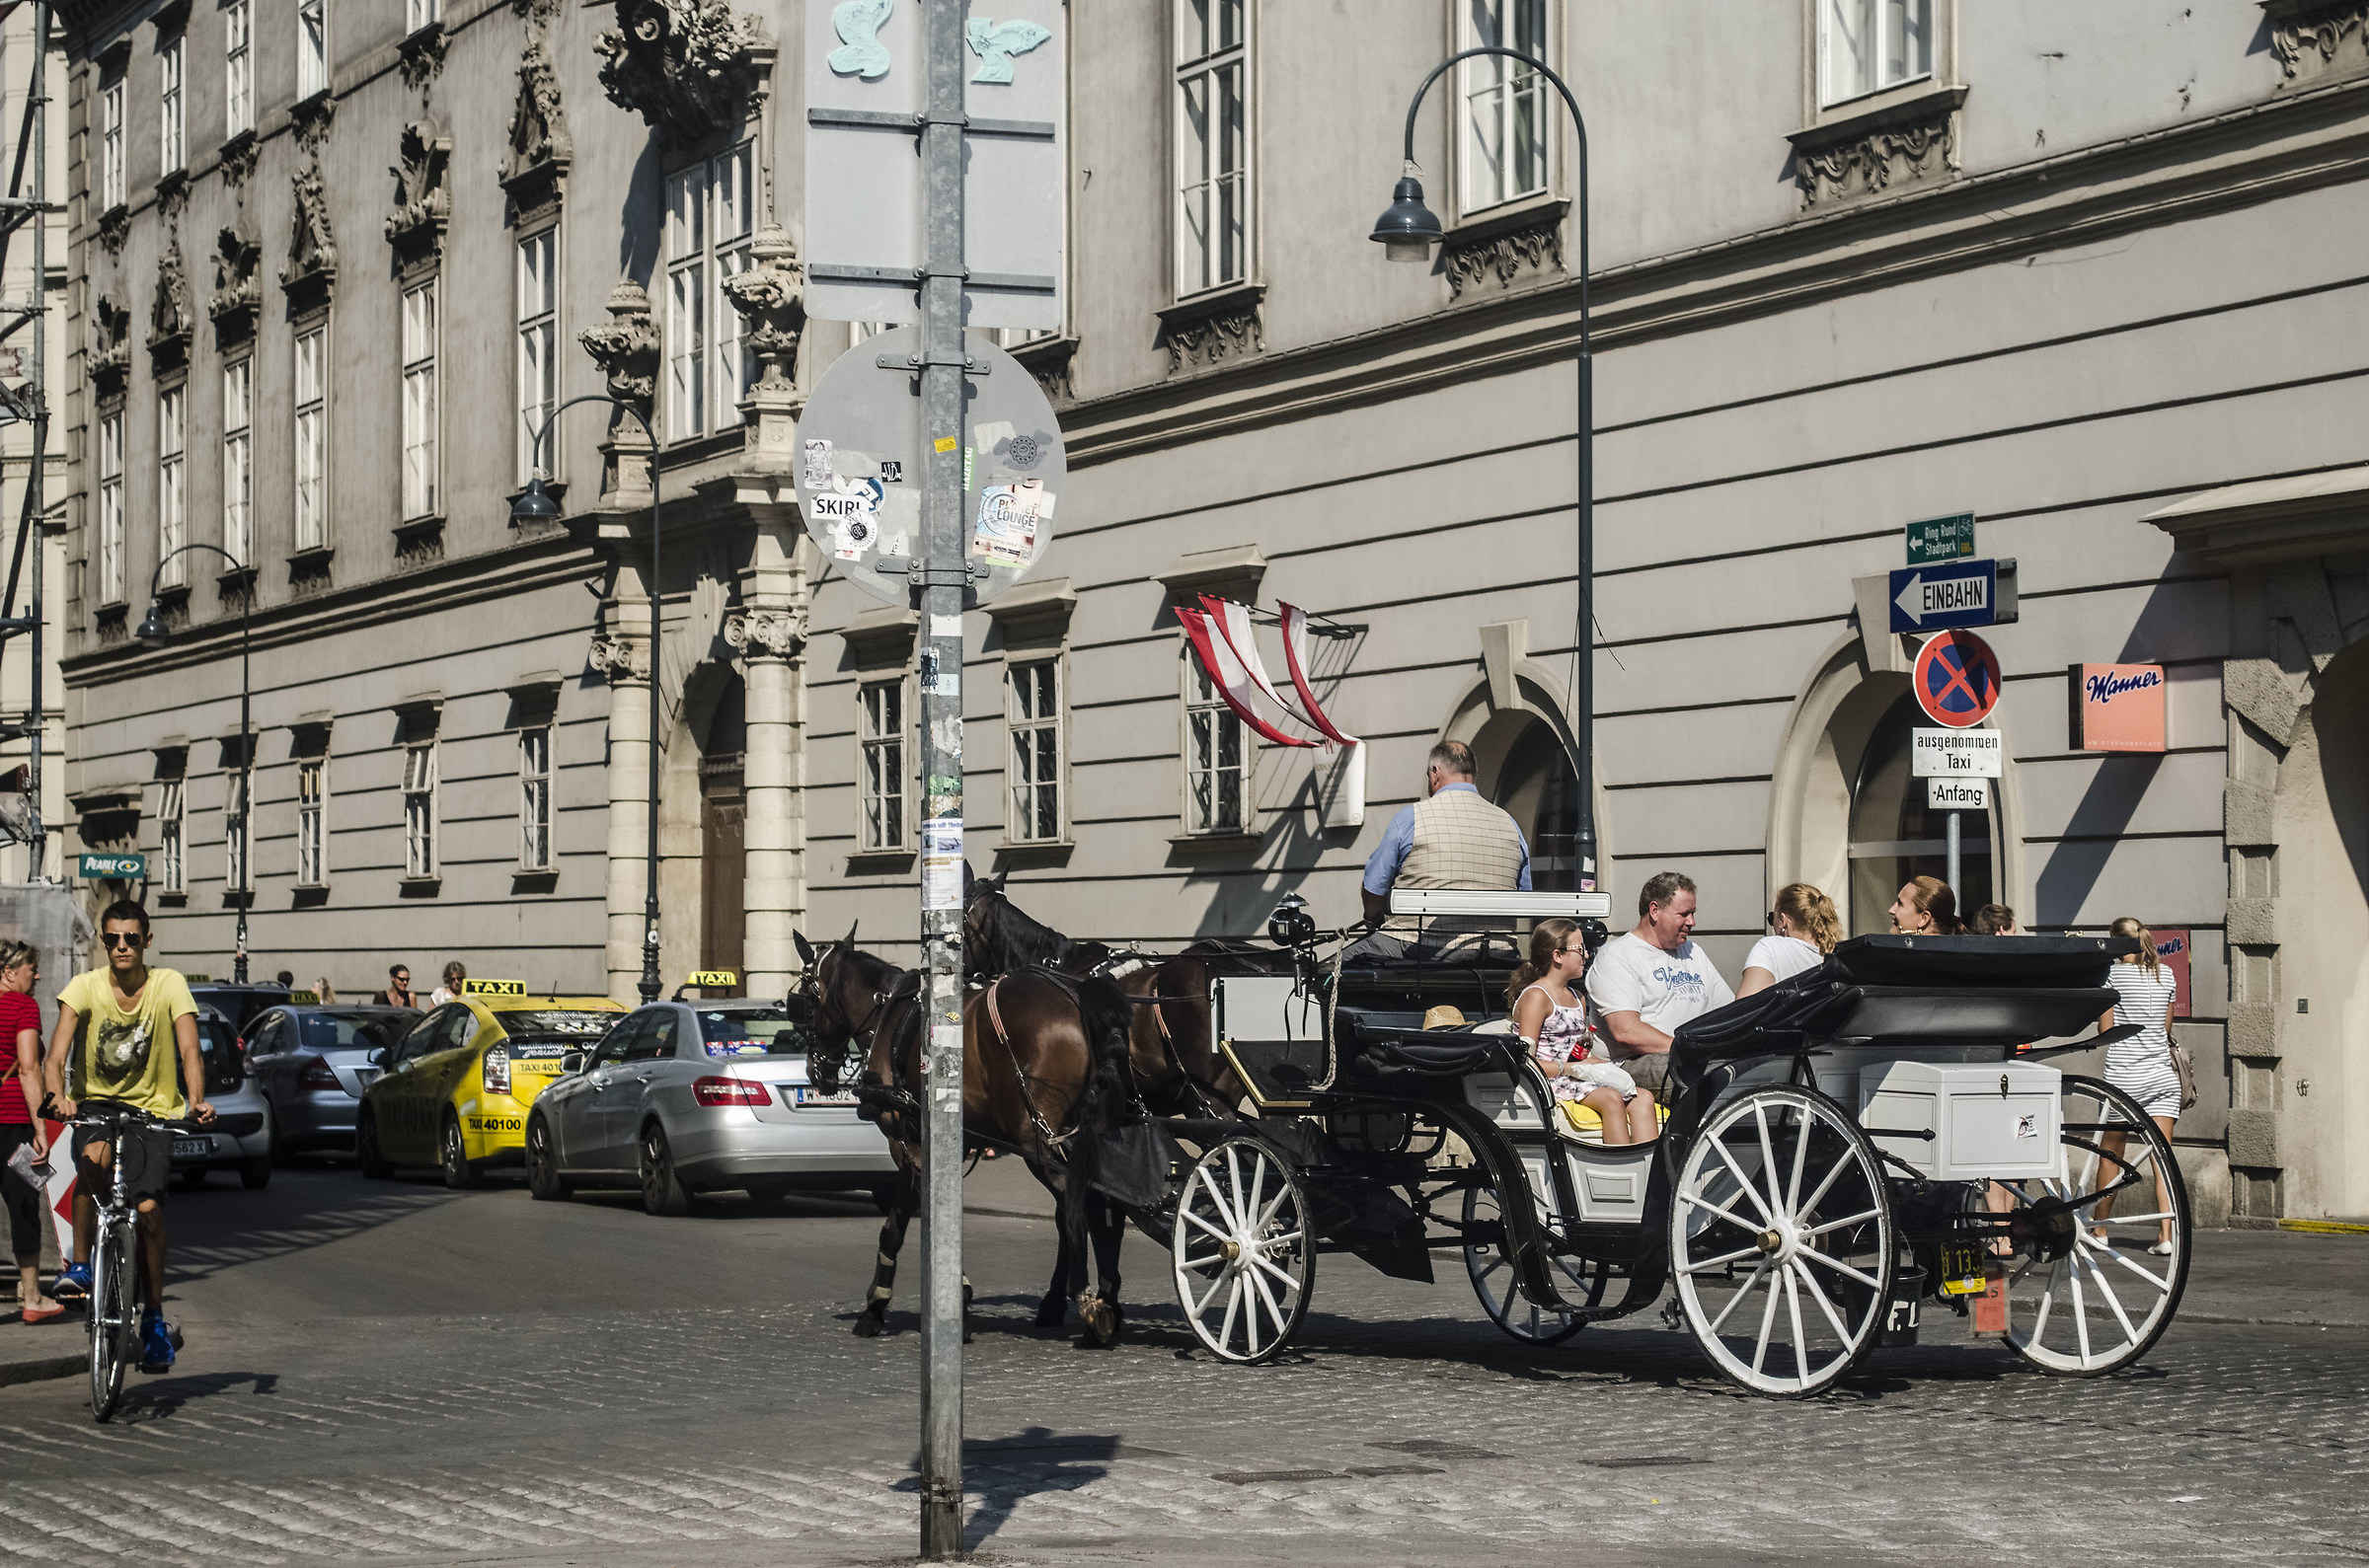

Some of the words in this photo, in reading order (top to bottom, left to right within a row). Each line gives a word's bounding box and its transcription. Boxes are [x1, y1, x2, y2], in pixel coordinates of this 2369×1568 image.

[996, 509, 1035, 528] LOUNGE
[1925, 526, 1939, 542] Ring
[1941, 523, 1956, 537] Rund
[1926, 540, 1956, 557] Stadtpark
[1923, 579, 1982, 611] EINBAHN
[2087, 671, 2162, 703] Manner
[1918, 736, 1998, 751] ausgenommen
[1947, 754, 1970, 769] Taxi
[1936, 784, 1982, 805] Anfang
[697, 973, 730, 985] TAXI
[471, 982, 518, 994] TAXI
[520, 1064, 540, 1073] TAXI
[805, 1088, 814, 1100] W
[469, 1118, 483, 1130] TAXI
[484, 1119, 521, 1131] 40100
